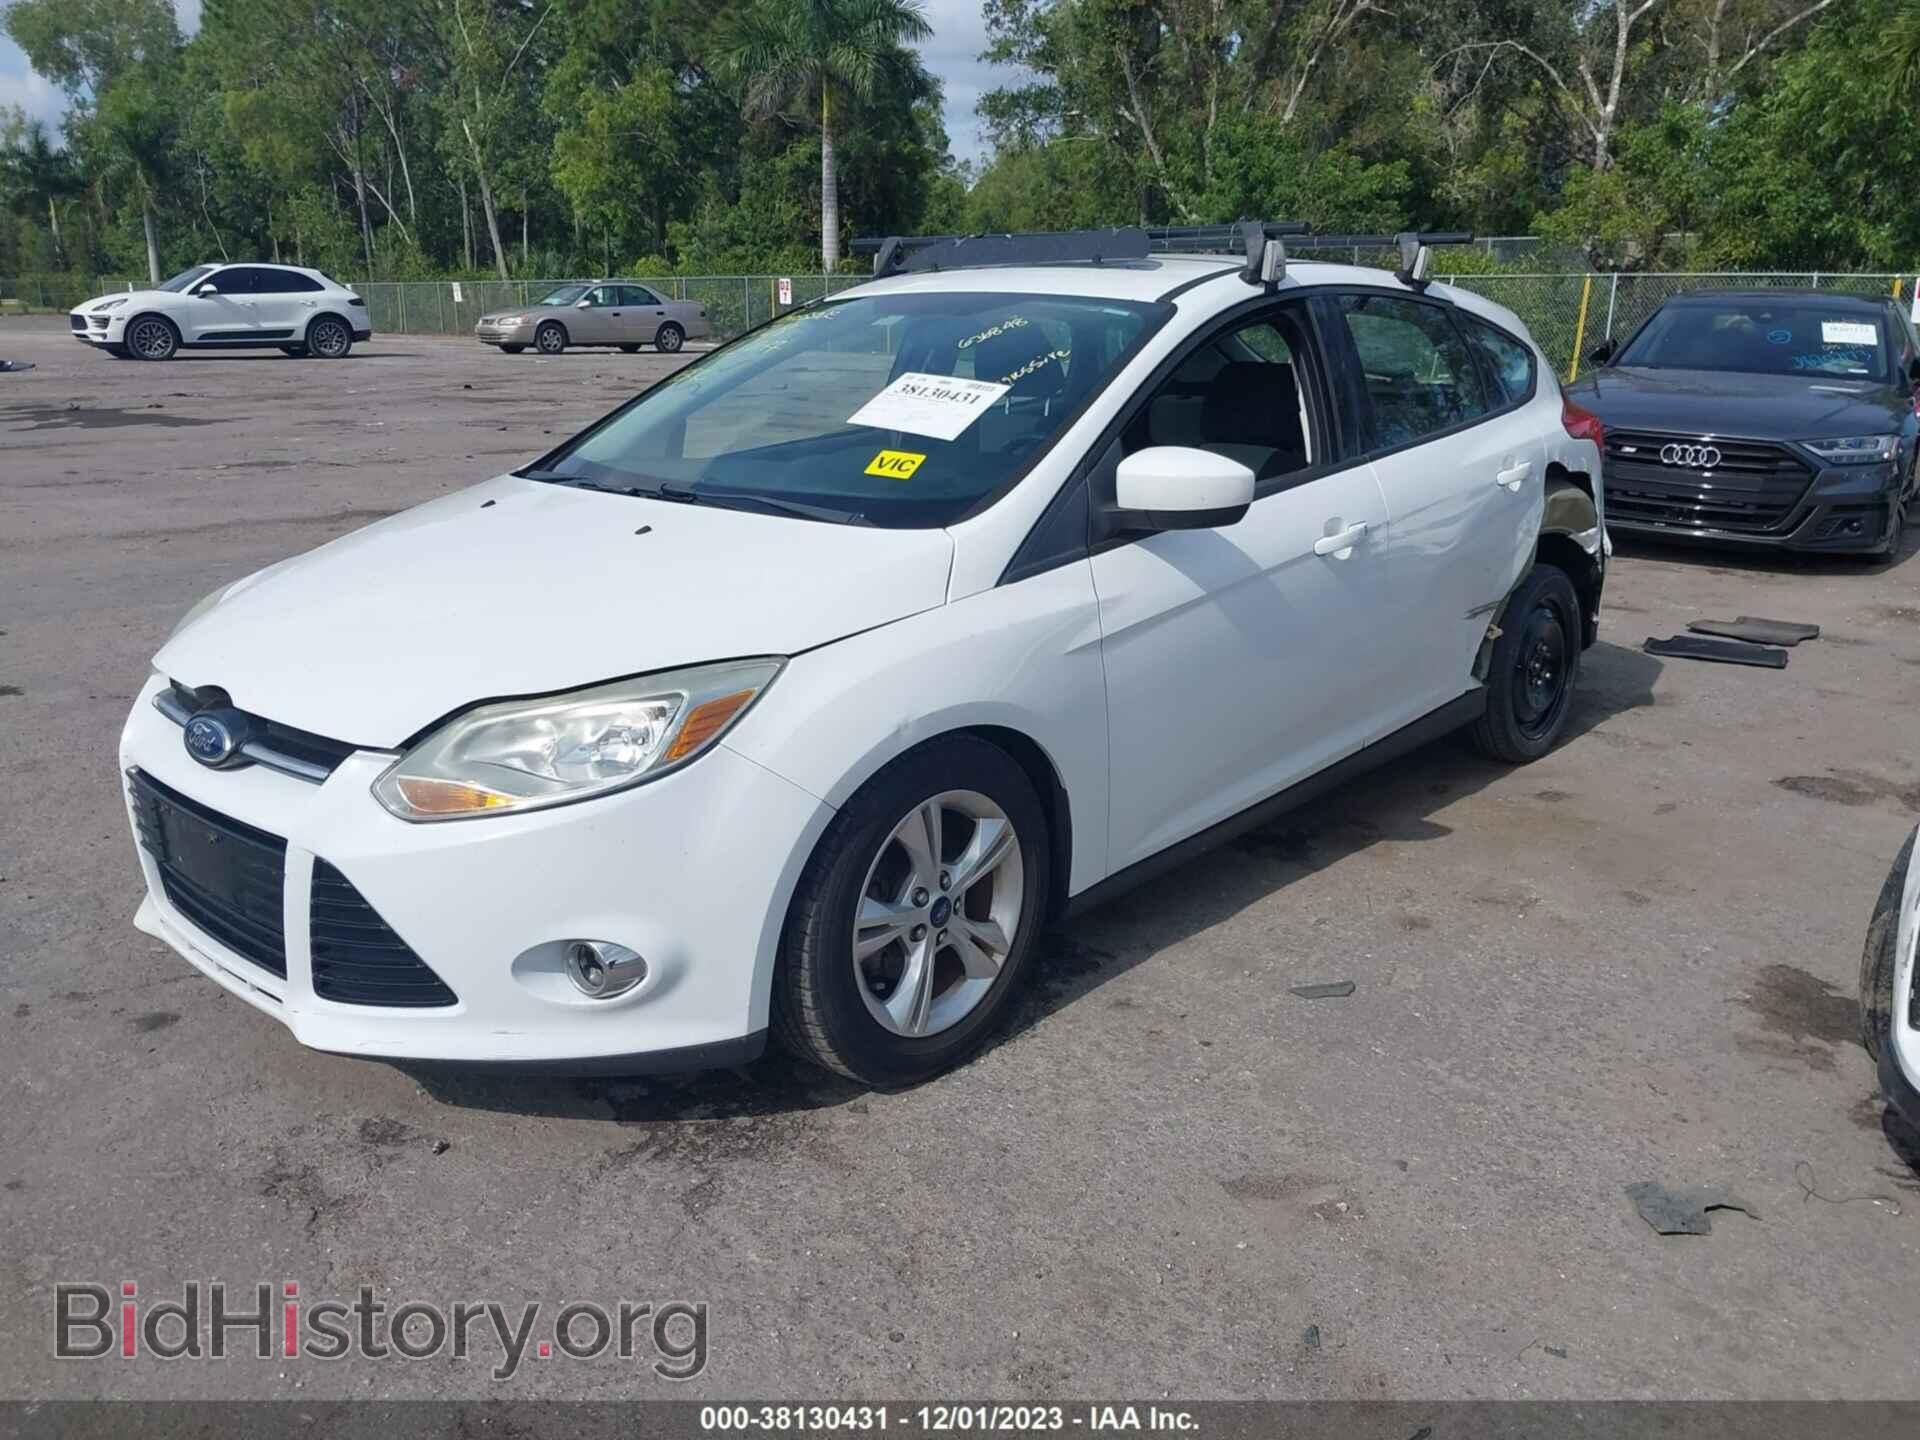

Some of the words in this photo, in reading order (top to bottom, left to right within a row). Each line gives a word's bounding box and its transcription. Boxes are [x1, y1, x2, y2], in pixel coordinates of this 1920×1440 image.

[895, 383, 981, 405] 38130431
[877, 456, 916, 473] VIC
[189, 722, 216, 752] Ford
